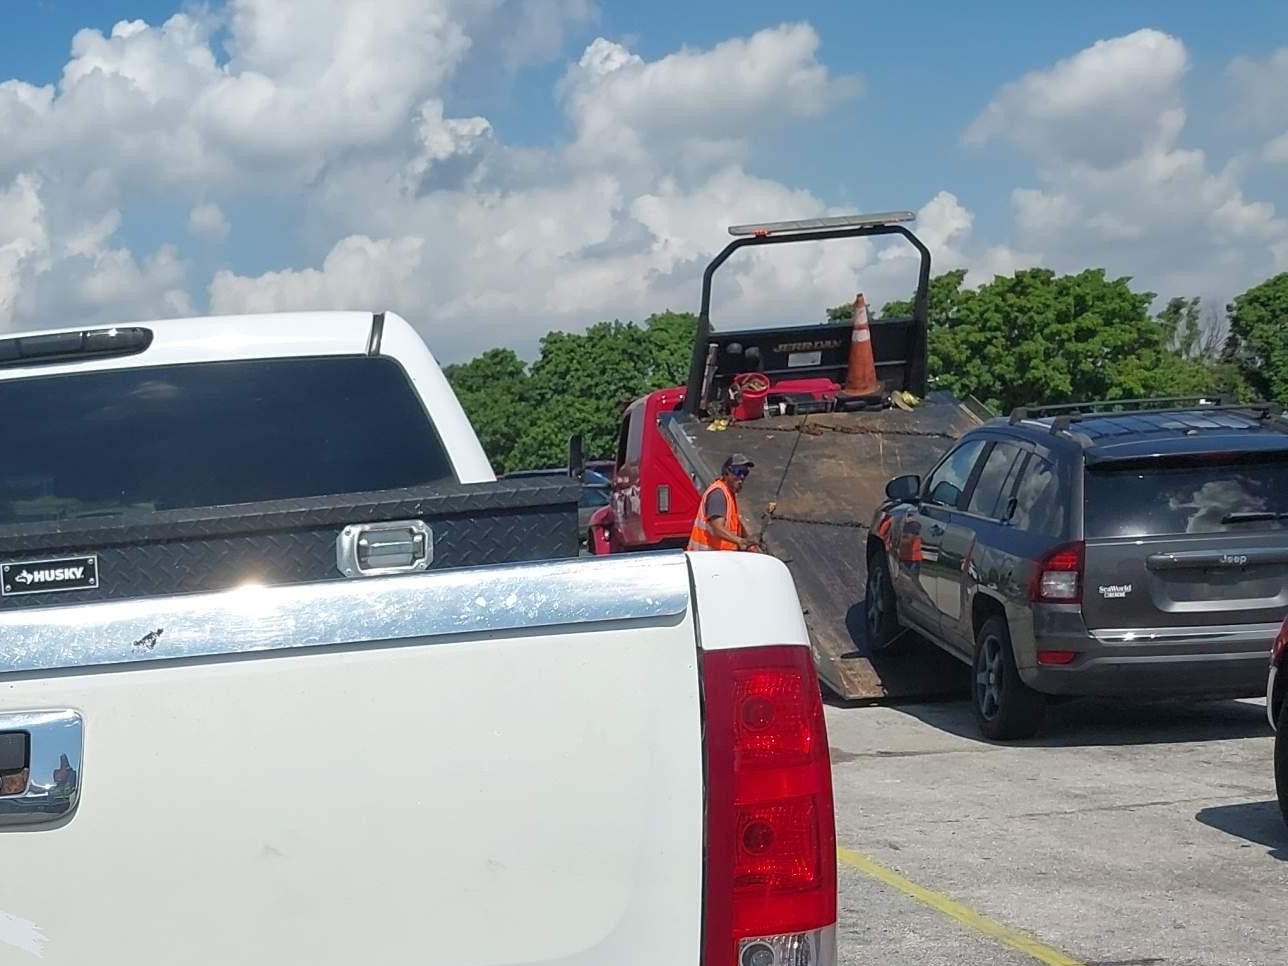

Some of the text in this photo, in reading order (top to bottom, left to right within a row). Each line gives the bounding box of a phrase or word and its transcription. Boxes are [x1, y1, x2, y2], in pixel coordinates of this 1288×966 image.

[1220, 554, 1247, 564] Jeep
[33, 567, 84, 582] HUSKY
[1098, 584, 1132, 593] SeaWorld
